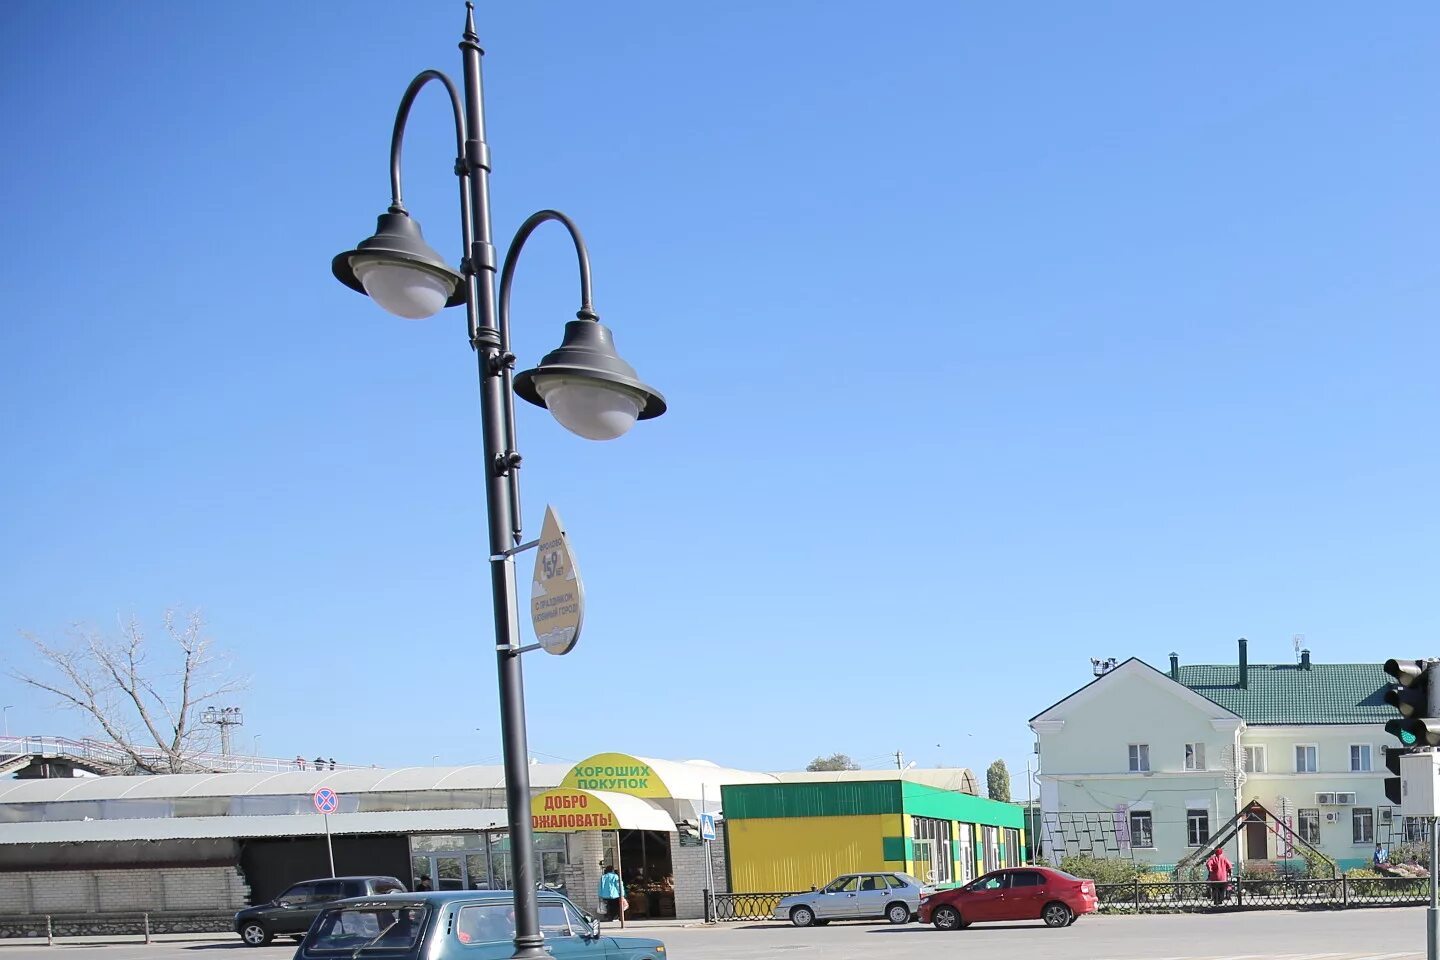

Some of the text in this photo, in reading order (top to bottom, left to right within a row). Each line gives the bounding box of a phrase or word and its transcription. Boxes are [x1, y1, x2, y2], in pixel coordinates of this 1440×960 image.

[575, 766, 650, 778] ХОРОШИХ
[578, 779, 648, 789] ПОКУПОК
[545, 795, 587, 811] ДОБРО
[531, 813, 612, 829] ОЖАЛОВАТЬ!
